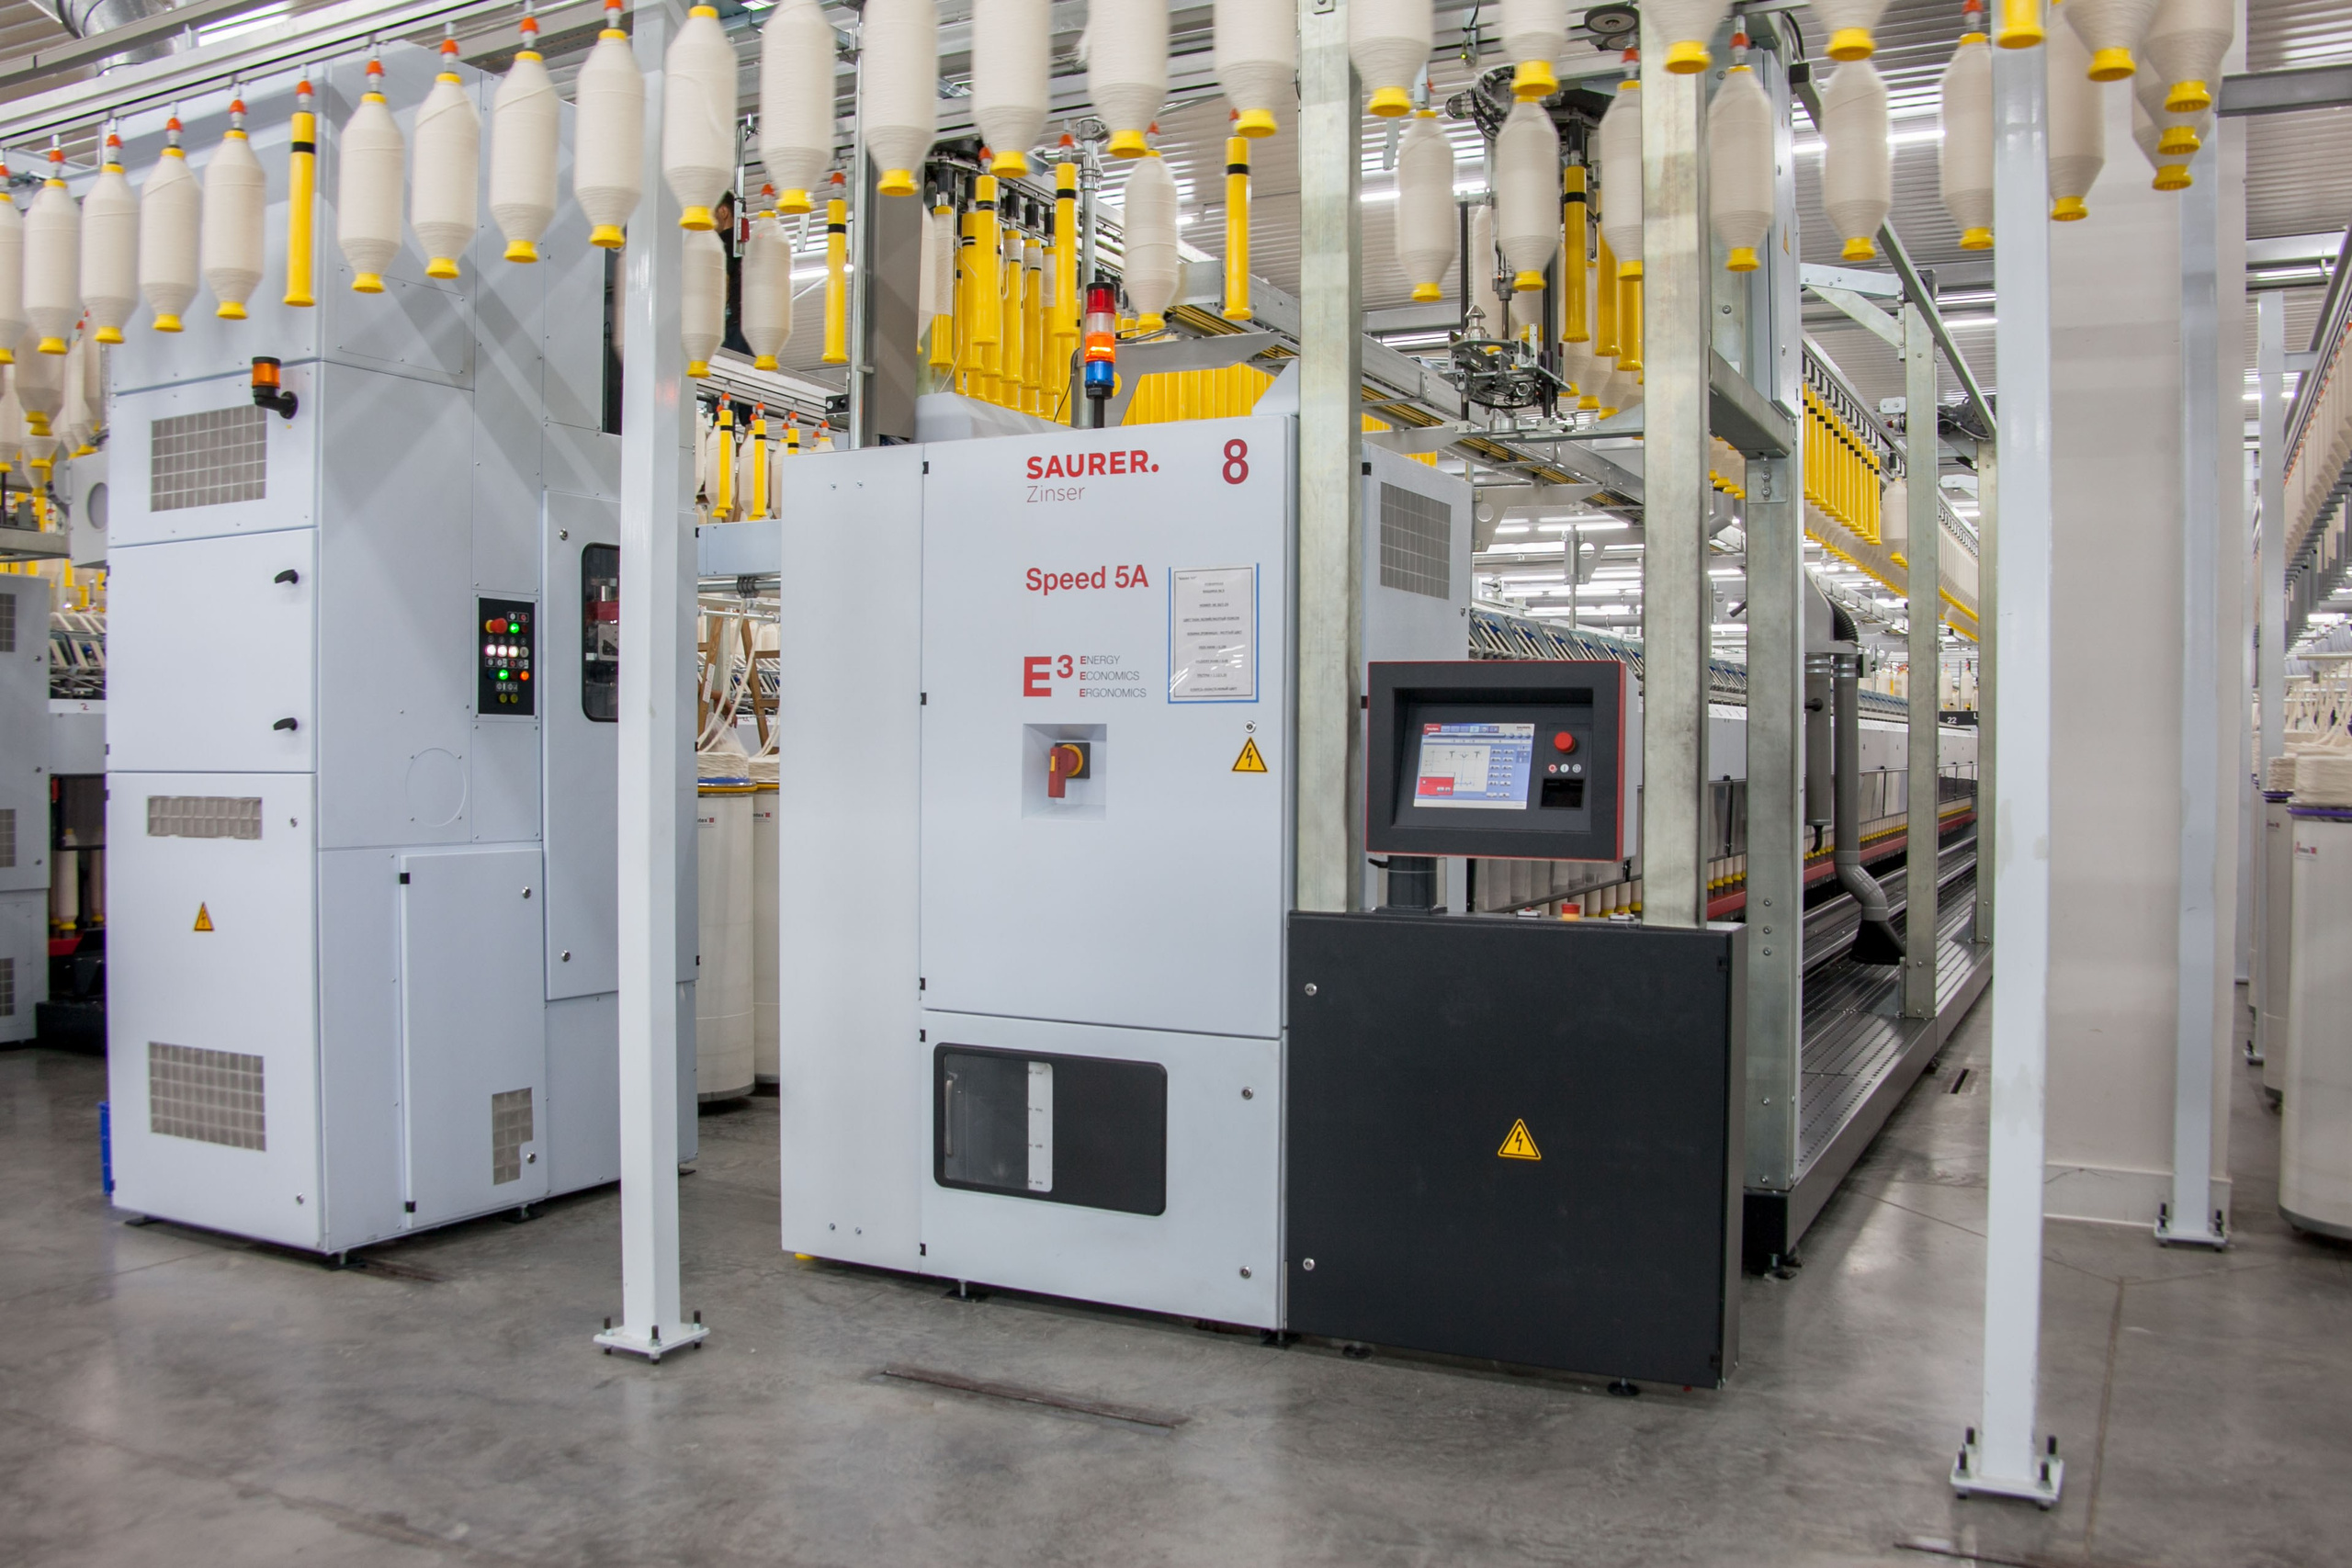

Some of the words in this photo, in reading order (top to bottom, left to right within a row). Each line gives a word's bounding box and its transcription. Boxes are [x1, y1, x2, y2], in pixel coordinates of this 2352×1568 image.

[1026, 449, 1159, 479] SAURER.
[1222, 438, 1250, 485] 8
[1026, 485, 1086, 503] Zinser
[1025, 565, 1106, 596] Speed
[1114, 564, 1149, 589] 5A
[1080, 655, 1121, 665] ENERGY
[1080, 671, 1140, 682] ECONOMICS
[1080, 687, 1148, 698] ERGONOMICS
